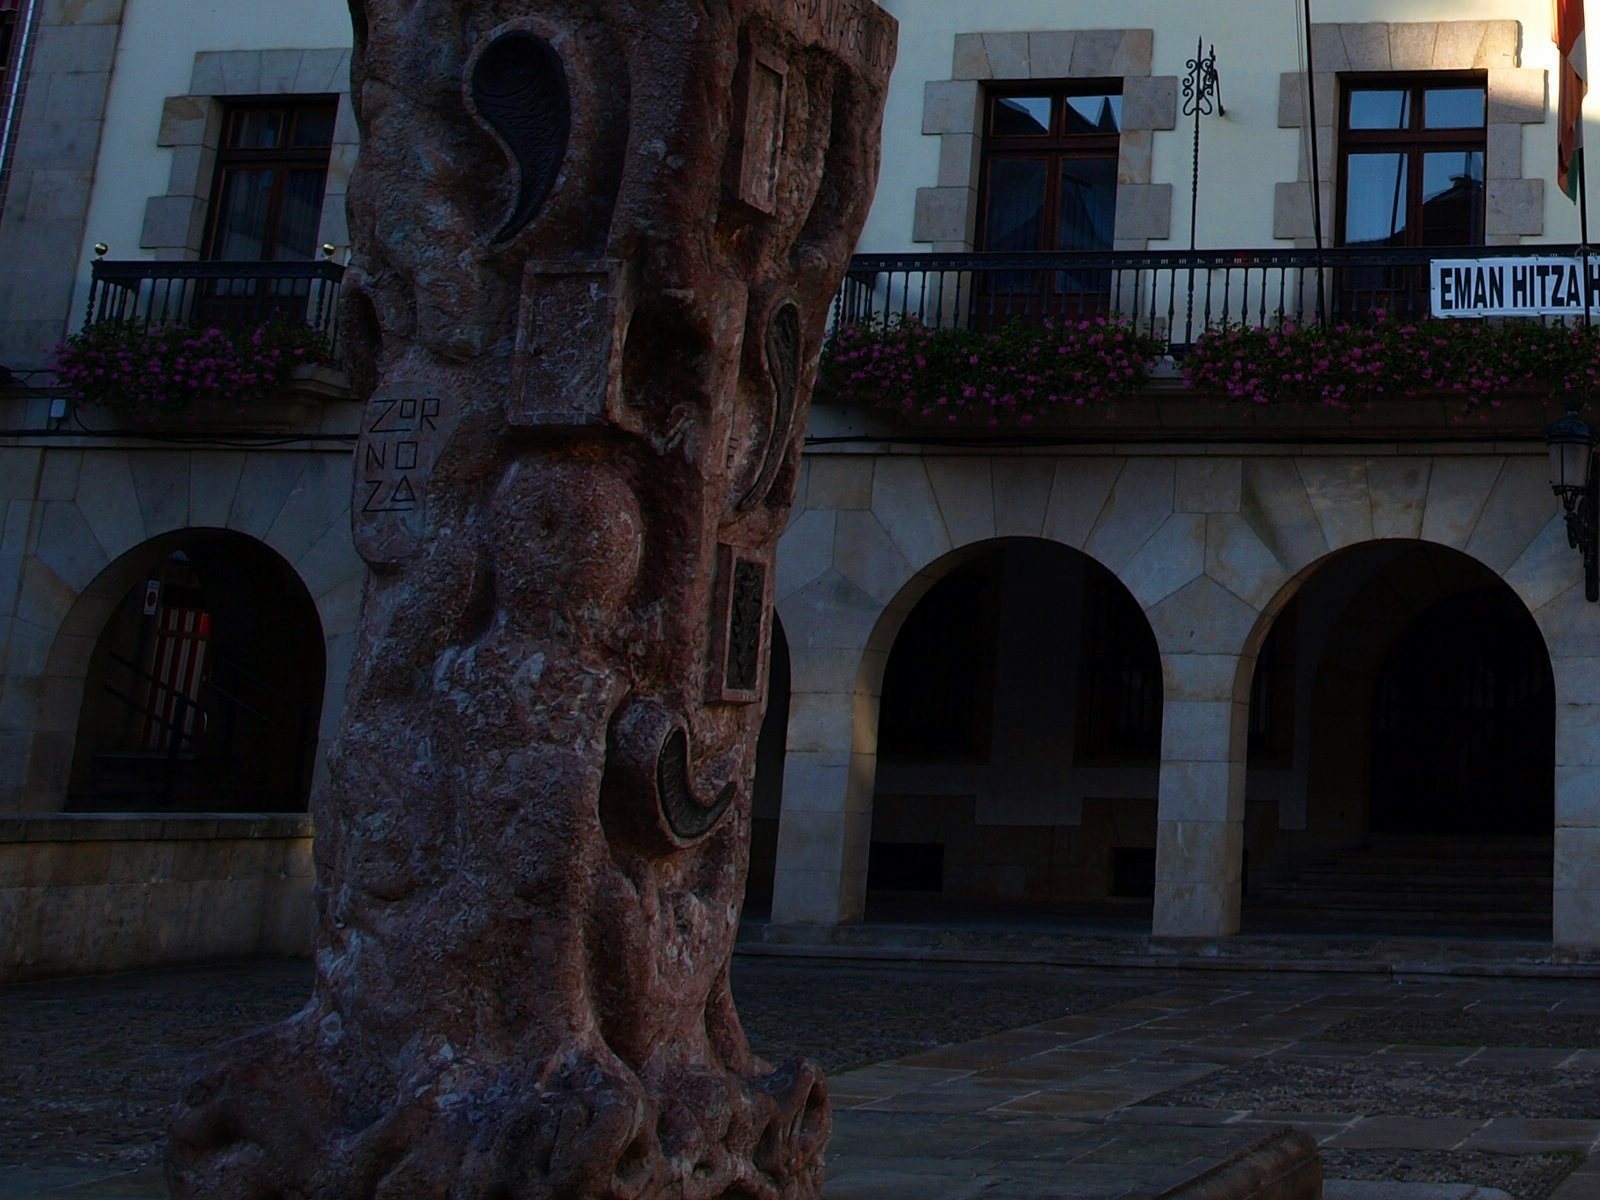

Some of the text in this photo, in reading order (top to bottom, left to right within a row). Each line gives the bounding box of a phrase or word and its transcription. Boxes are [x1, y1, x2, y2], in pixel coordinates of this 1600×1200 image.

[1440, 266, 1504, 310] EMAN
[1512, 264, 1582, 308] HITZA
[369, 399, 440, 432] ZOR
[366, 441, 418, 472] NO
[362, 475, 416, 512] ZA
